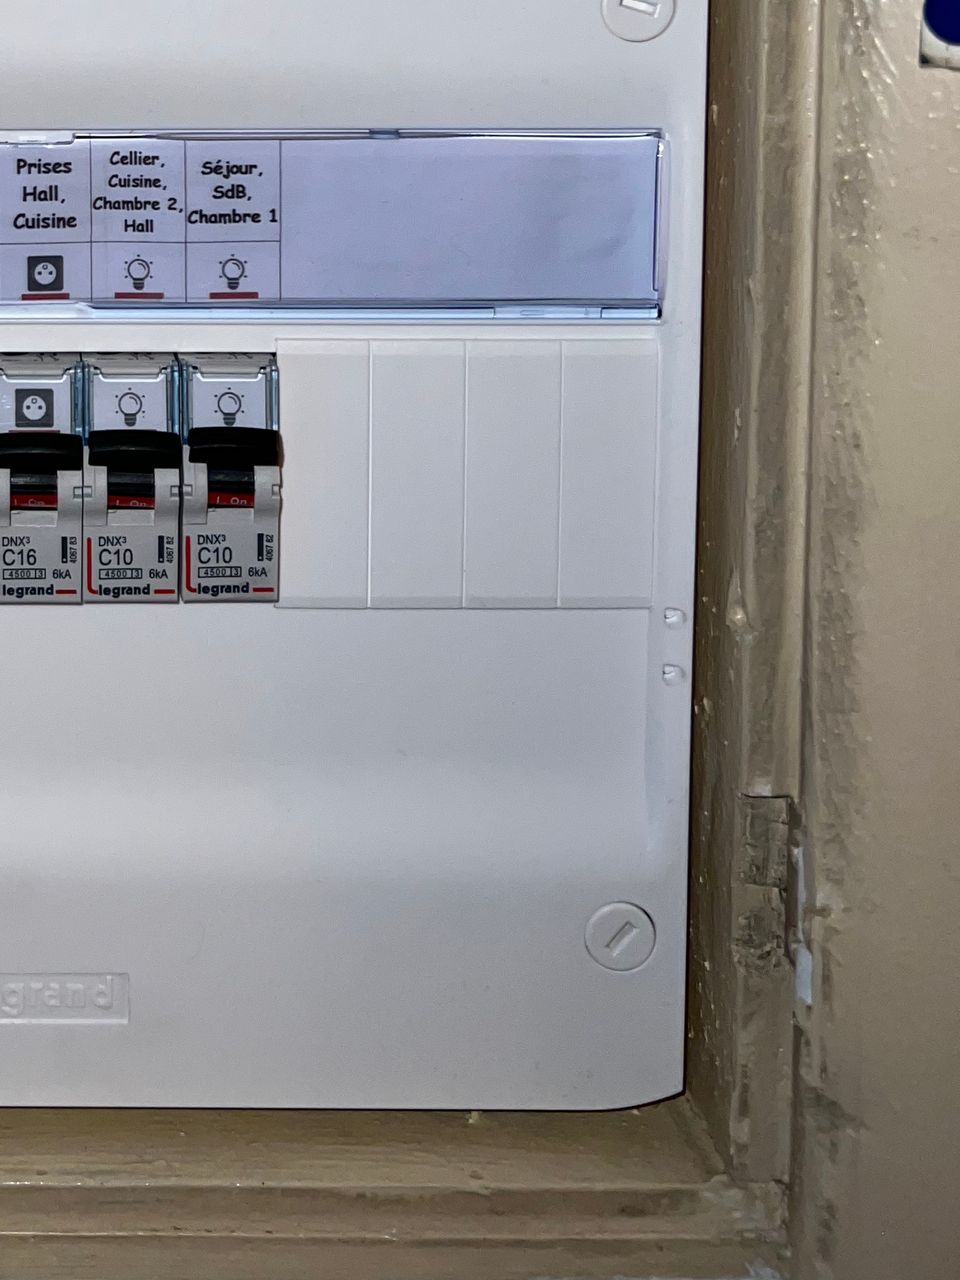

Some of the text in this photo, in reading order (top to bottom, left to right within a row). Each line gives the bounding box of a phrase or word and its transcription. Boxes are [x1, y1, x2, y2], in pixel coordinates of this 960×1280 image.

[17, 158, 72, 175] Prises
[109, 151, 165, 168] Cellier,
[201, 161, 264, 179] Séjour,
[108, 174, 167, 191] Cuisine,
[22, 186, 66, 204] Hall,
[213, 184, 252, 201] SdB,
[93, 197, 184, 214] Chambre 2,
[13, 213, 78, 230] Cuisine
[188, 209, 279, 225] Chambre 1
[124, 219, 154, 233] Hall
[3, 549, 37, 566] C16
[99, 549, 133, 566] C10
[198, 547, 233, 564] C10
[52, 569, 72, 579] 6kA
[149, 569, 168, 579] 6kA
[248, 567, 267, 577] 6kA
[3, 584, 54, 598] legrand
[99, 584, 150, 598] legrand
[198, 582, 249, 596] legrand
